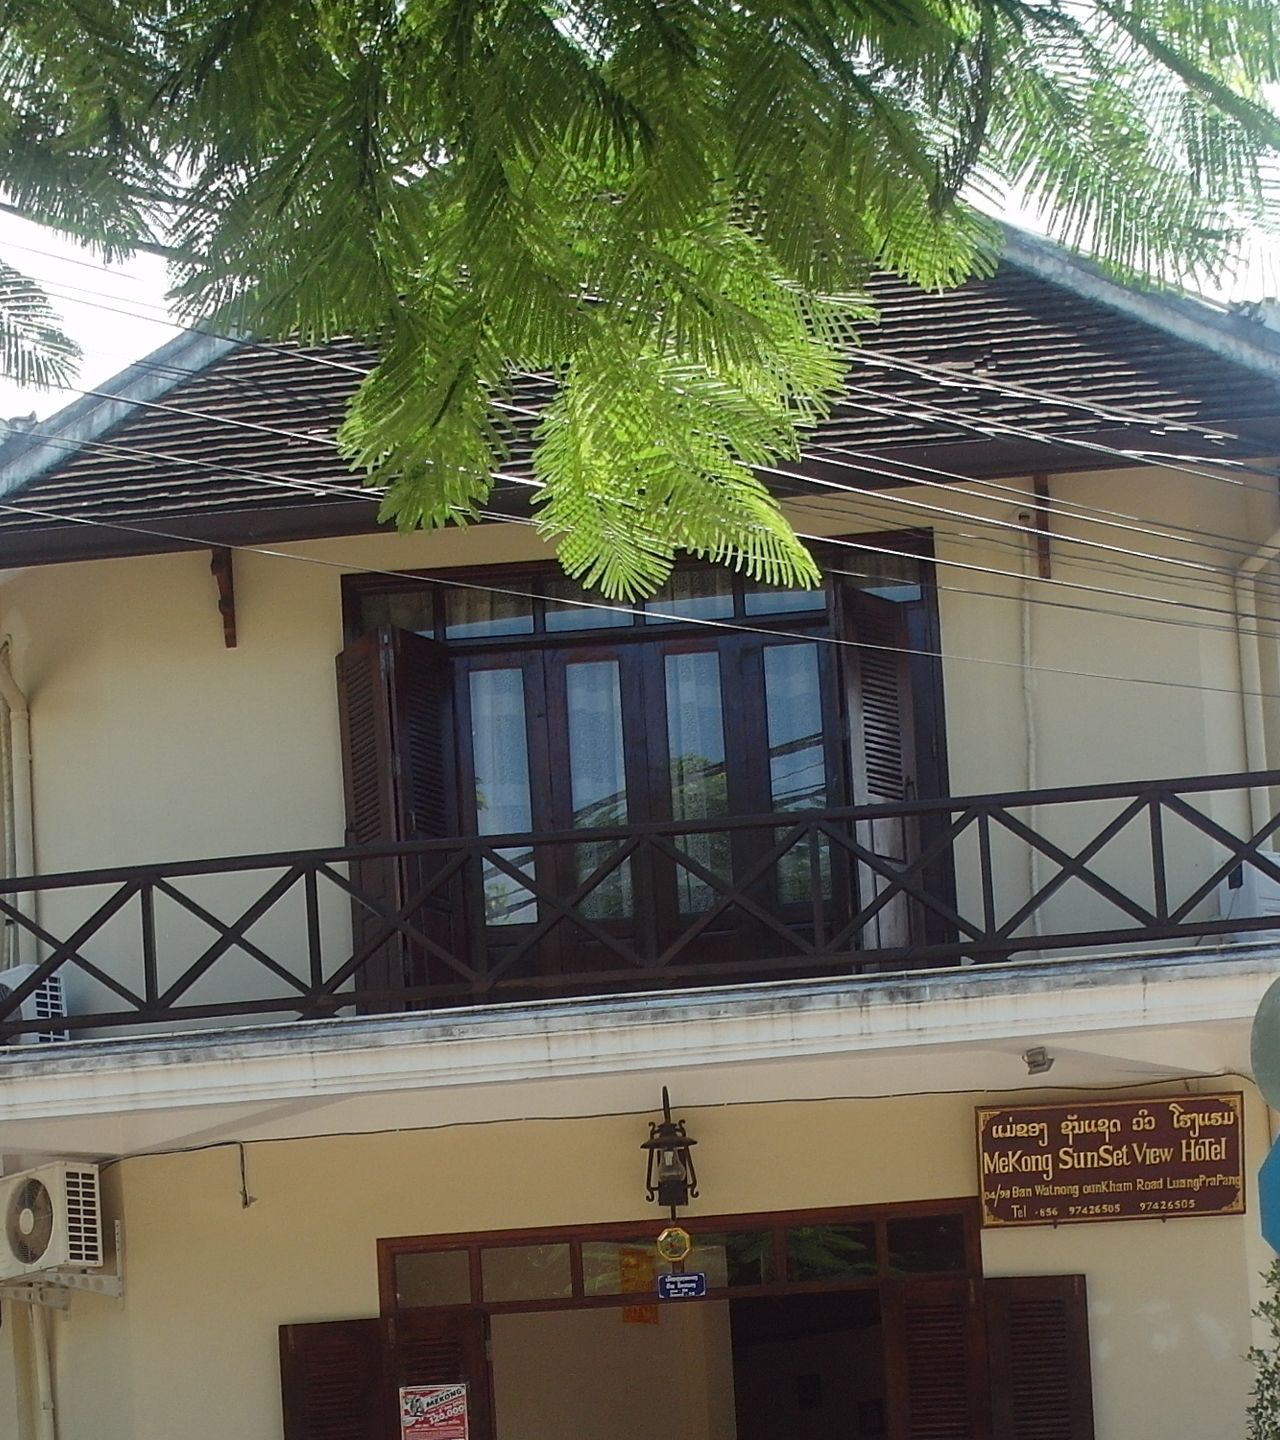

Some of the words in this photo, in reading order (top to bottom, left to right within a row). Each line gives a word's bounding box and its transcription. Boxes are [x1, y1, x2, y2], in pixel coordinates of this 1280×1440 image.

[983, 1149, 1054, 1180] MeKong
[1058, 1144, 1131, 1170] SunSet
[1011, 1186, 1033, 1198] Ban
[1136, 1178, 1164, 1191] Road
[1011, 1205, 1027, 1219] Tel
[1068, 1204, 1121, 1215] 97426505
[1139, 1199, 1196, 1211] 97426505
